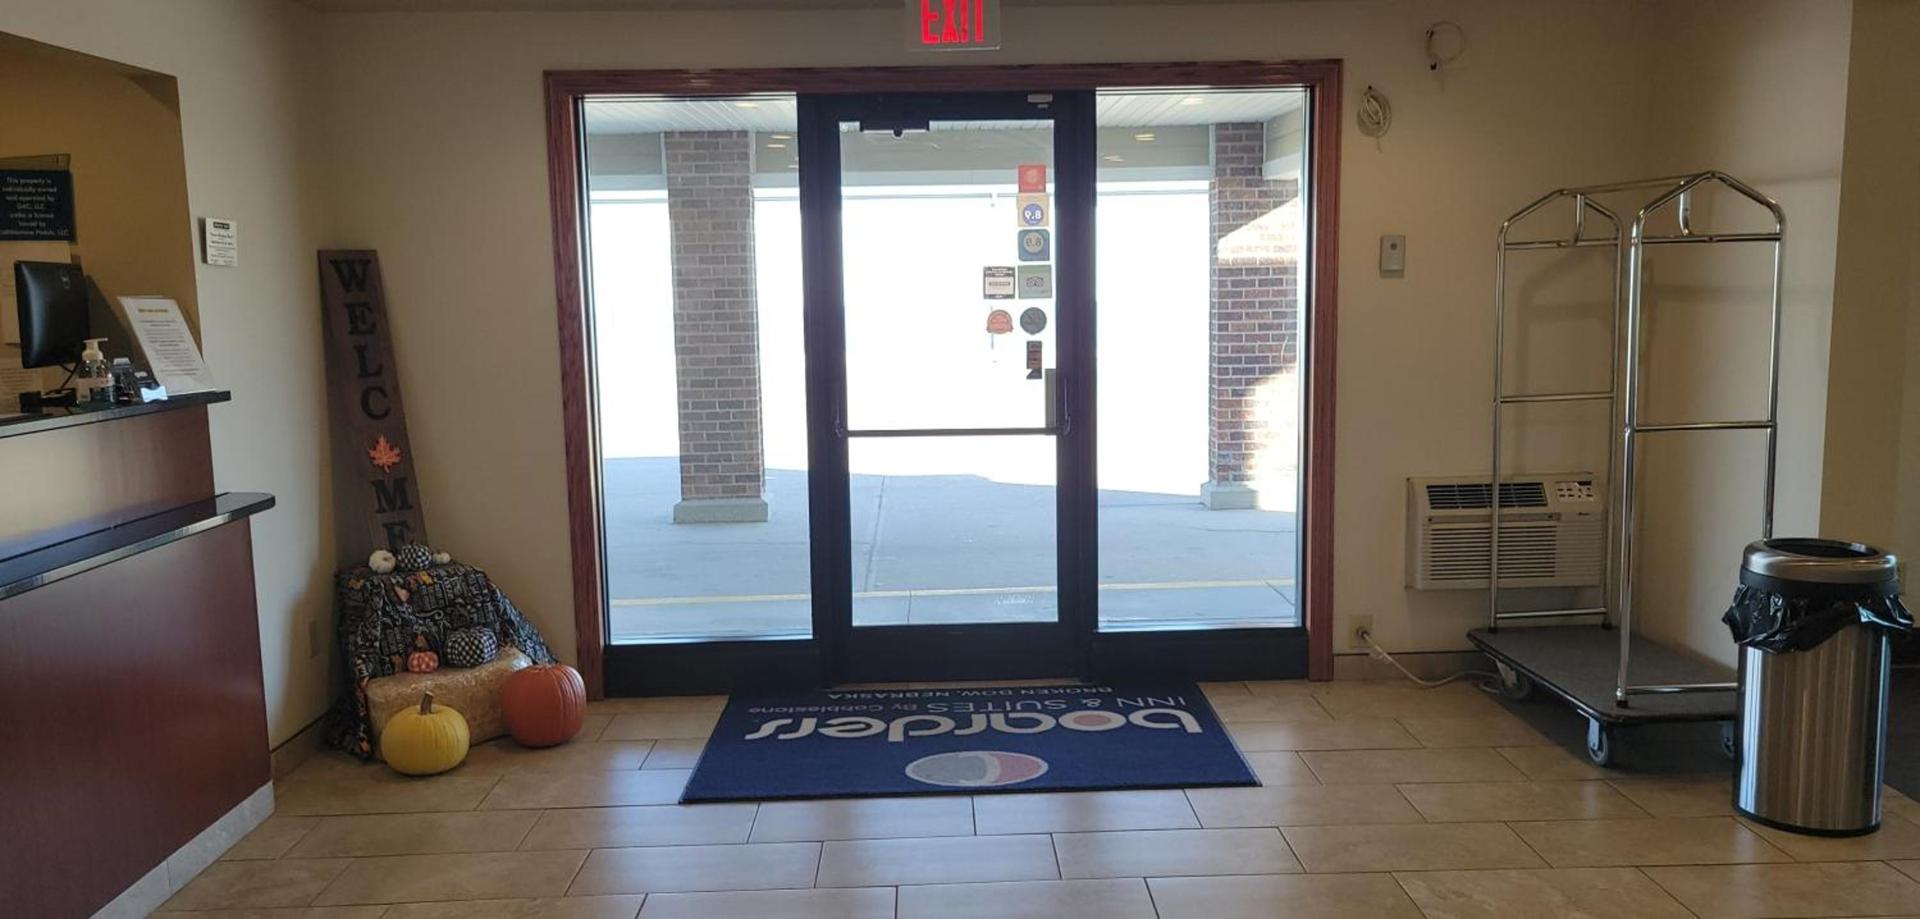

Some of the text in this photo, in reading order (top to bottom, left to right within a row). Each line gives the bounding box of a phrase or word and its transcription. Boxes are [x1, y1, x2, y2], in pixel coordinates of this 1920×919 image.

[921, 0, 984, 44] EXIT
[827, 691, 950, 700] NEBRASKA
[1117, 697, 1187, 707] INN
[927, 699, 1068, 713] SUITES
[744, 709, 1203, 742] boarders
